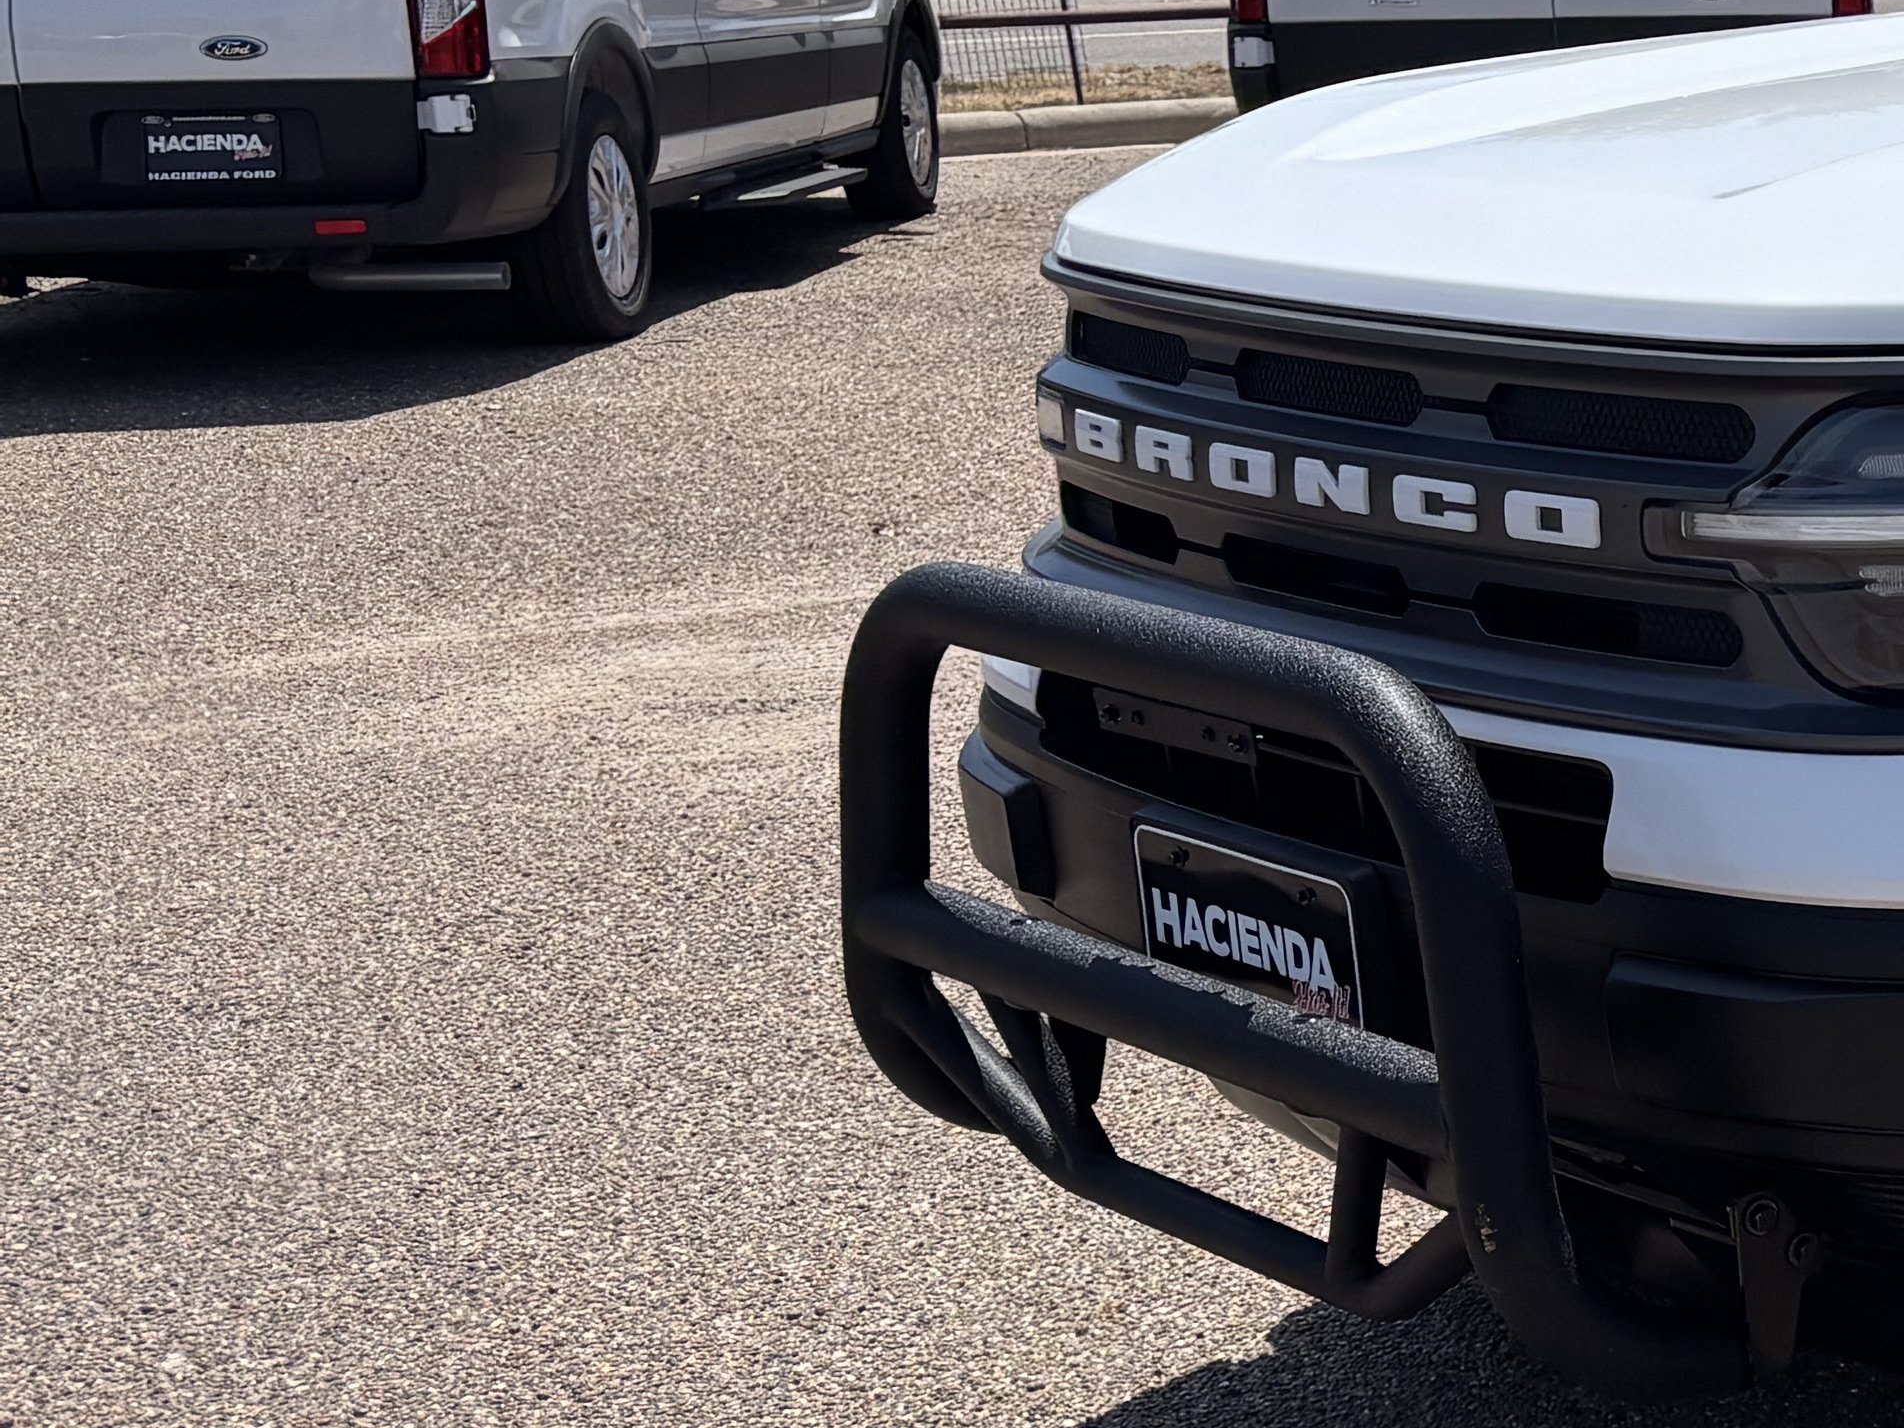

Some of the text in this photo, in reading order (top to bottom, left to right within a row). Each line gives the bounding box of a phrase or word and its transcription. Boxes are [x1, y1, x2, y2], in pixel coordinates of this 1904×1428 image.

[147, 132, 264, 154] HACIENDA
[148, 169, 277, 181] HACIENDA FORD
[1074, 407, 1601, 549] BRONCO
[1151, 886, 1336, 996] HACIENDA
